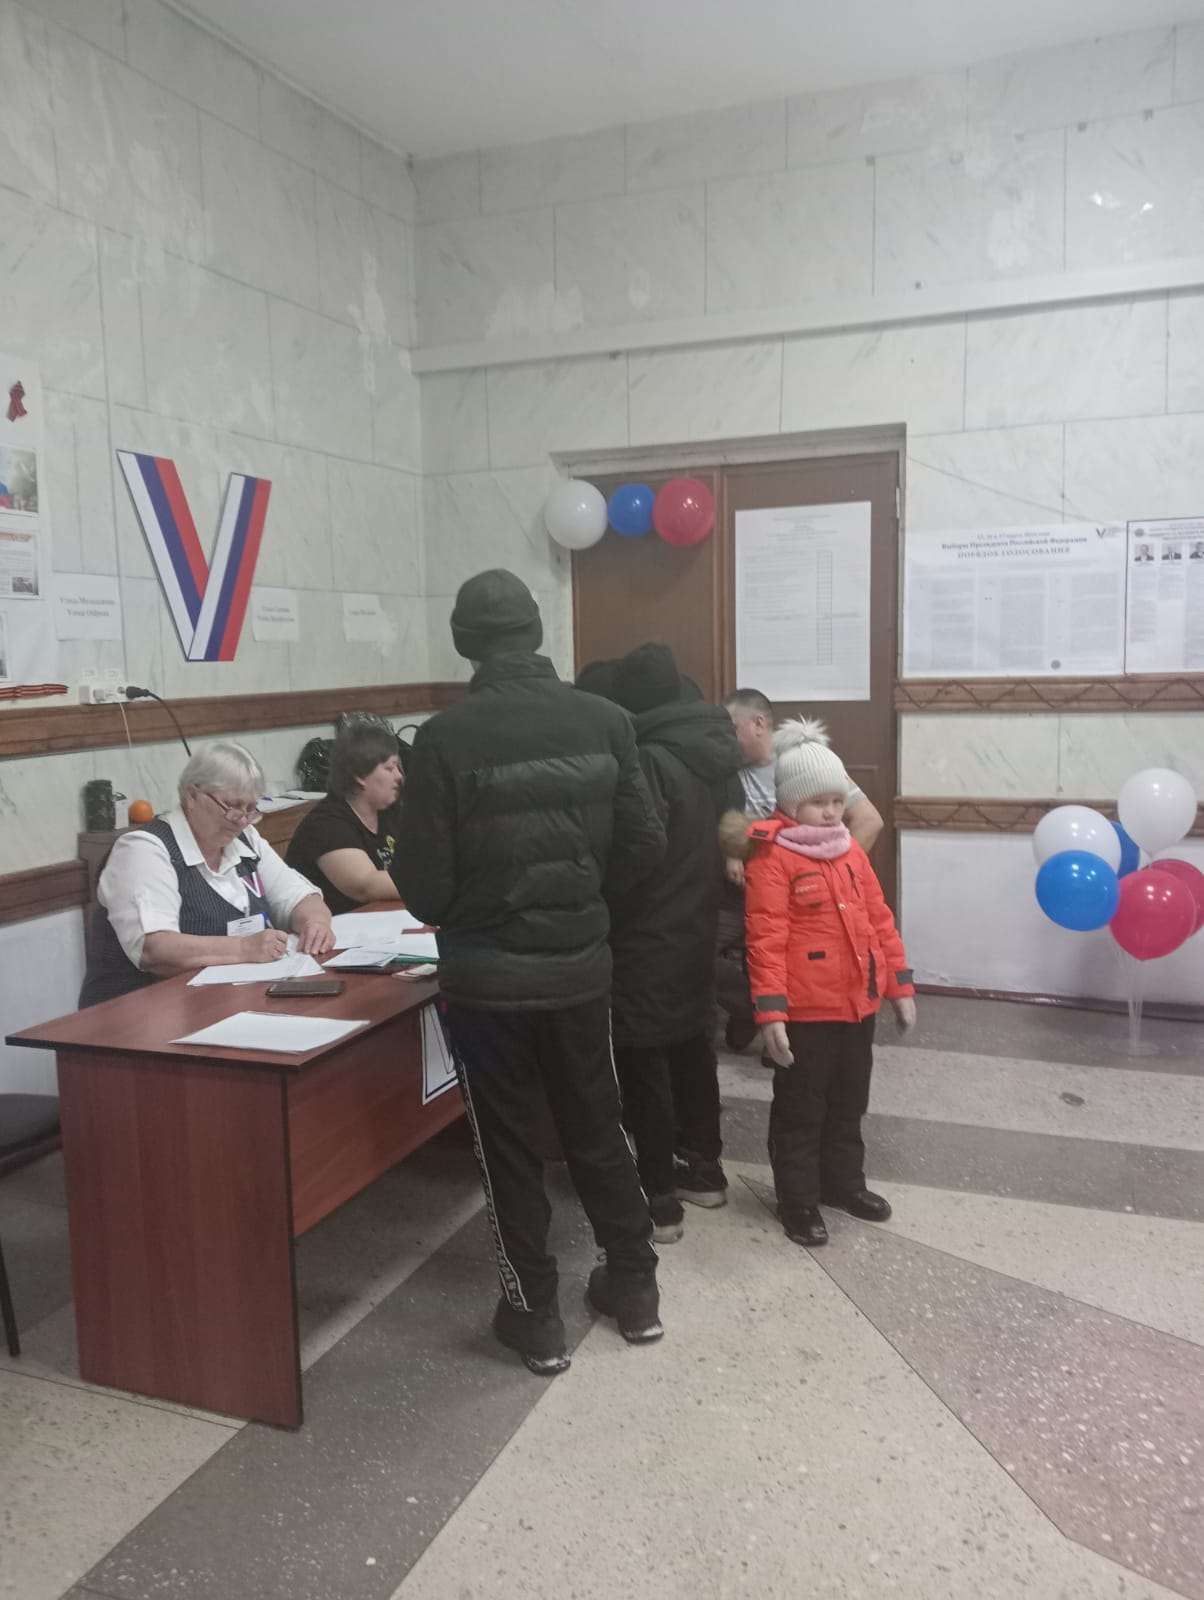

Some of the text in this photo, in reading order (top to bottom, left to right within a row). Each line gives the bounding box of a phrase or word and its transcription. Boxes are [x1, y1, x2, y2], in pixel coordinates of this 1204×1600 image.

[942, 536, 1088, 550] Выборы Президента Российской Федерации
[957, 546, 1071, 560] ПОРЯДОК ГОЛОСОВАНИЯ
